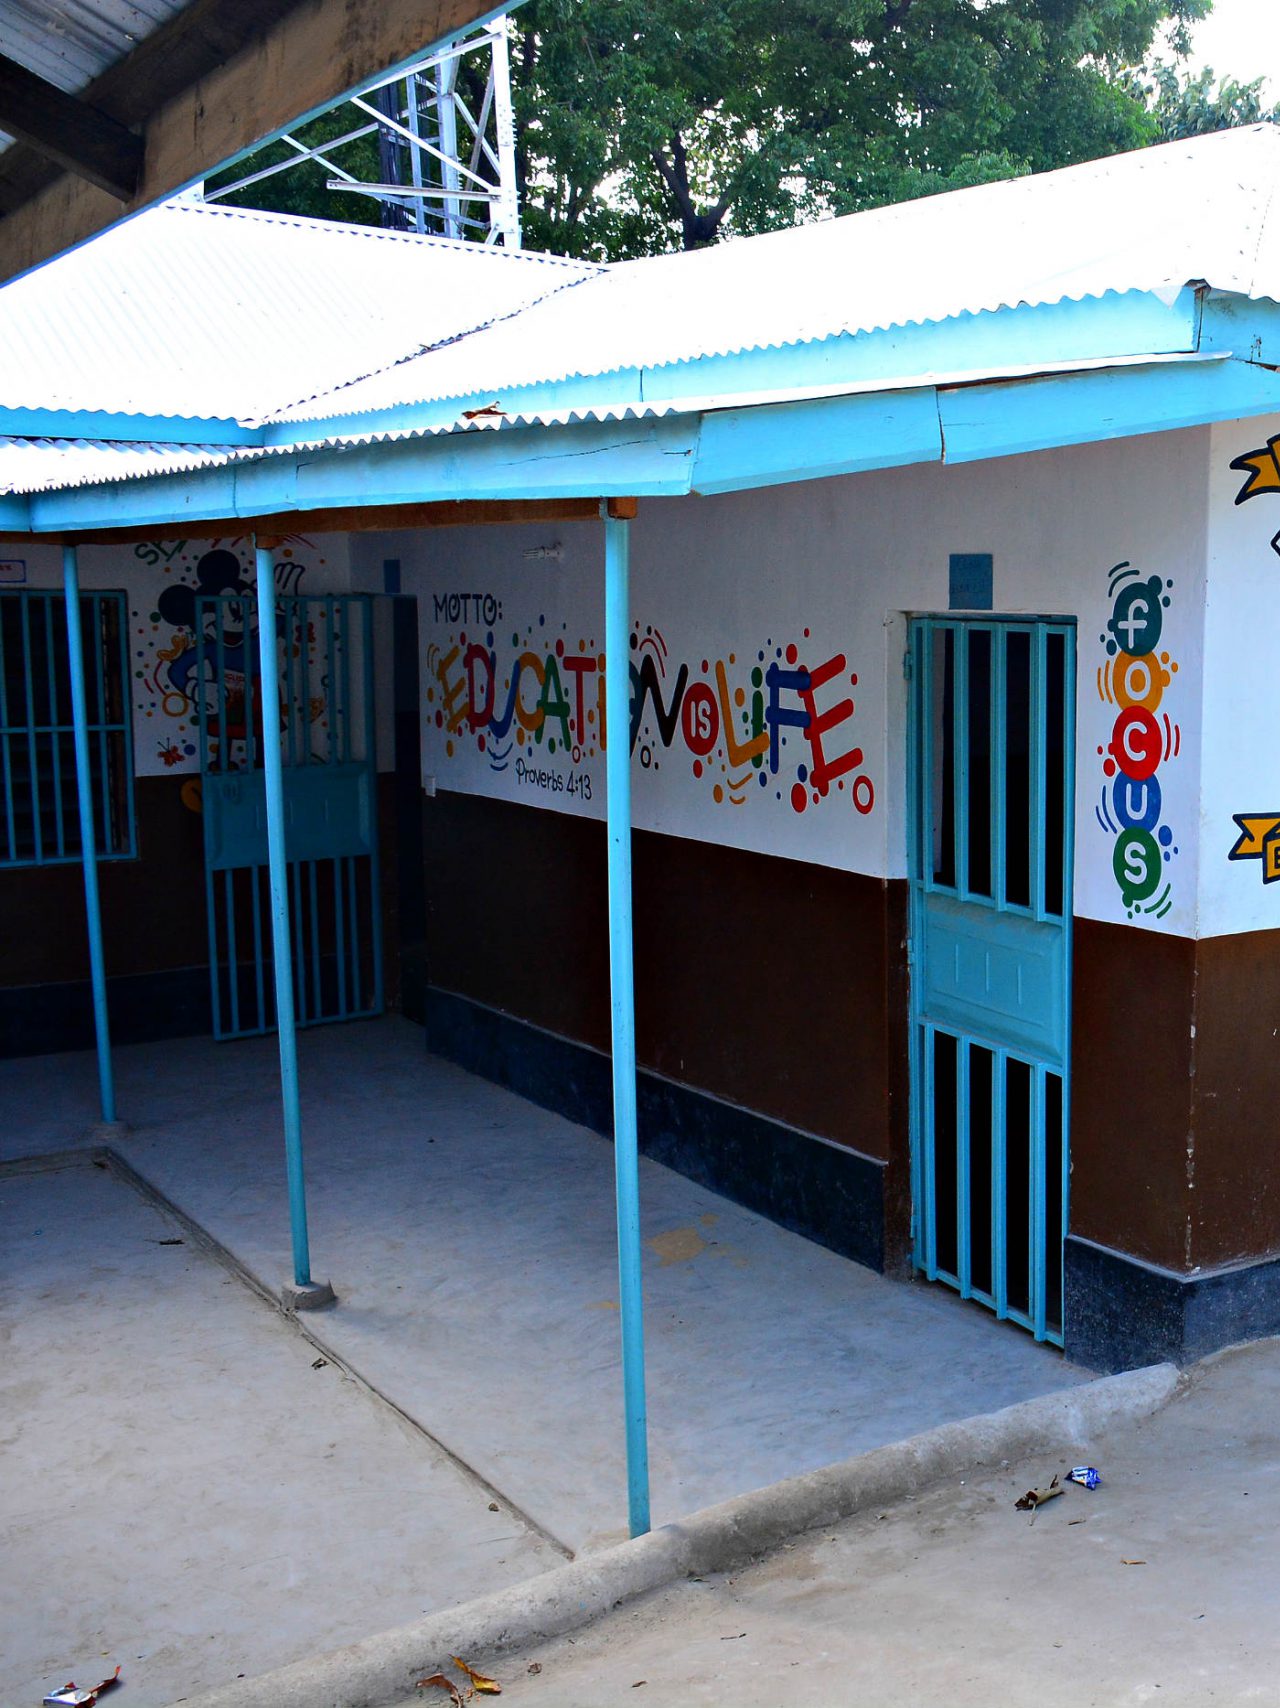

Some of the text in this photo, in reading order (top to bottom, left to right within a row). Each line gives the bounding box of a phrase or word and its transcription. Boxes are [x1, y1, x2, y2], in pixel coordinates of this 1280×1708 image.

[433, 593, 503, 626] MOTTO:
[690, 699, 711, 740] IS
[515, 757, 592, 800] Proverbs 4:13
